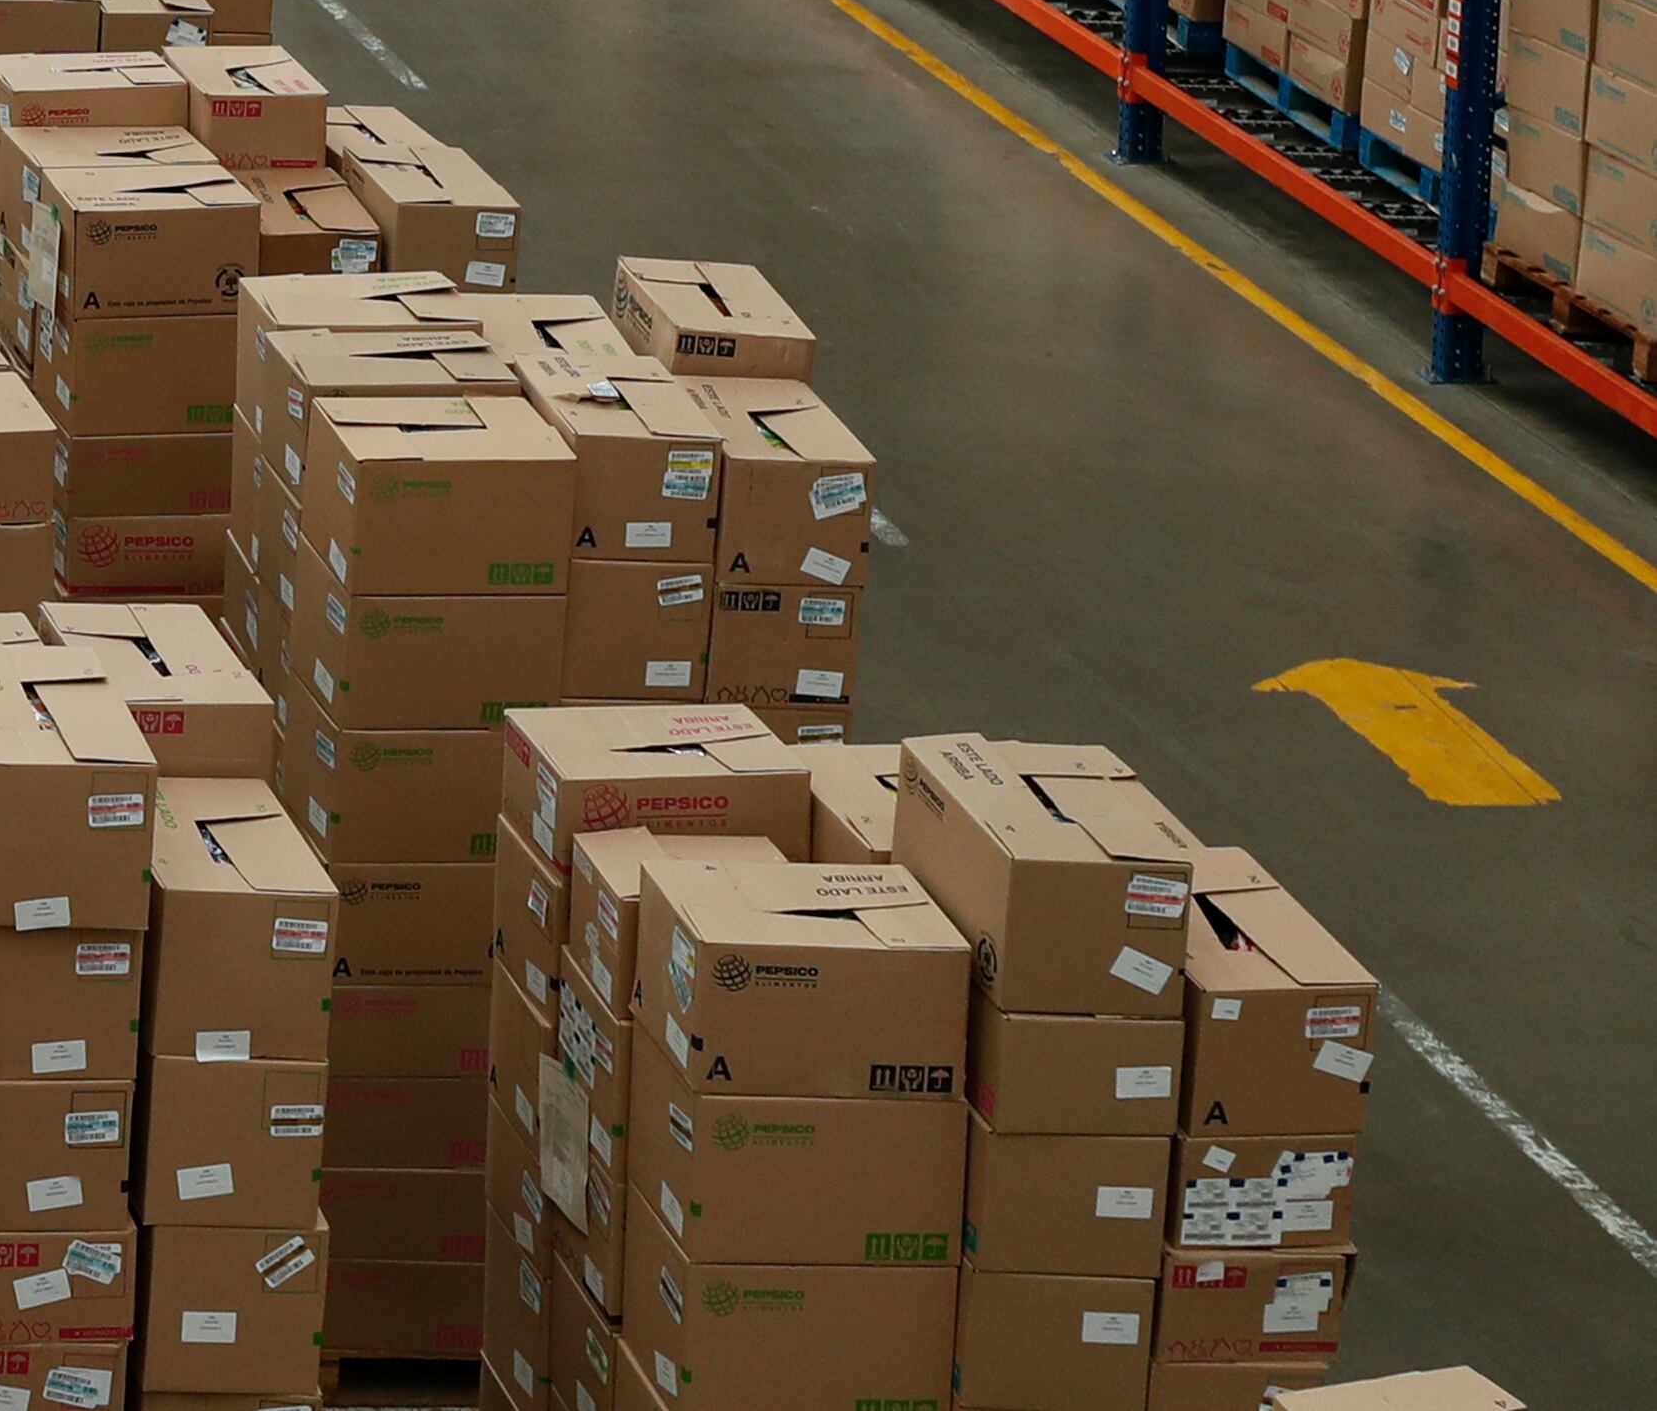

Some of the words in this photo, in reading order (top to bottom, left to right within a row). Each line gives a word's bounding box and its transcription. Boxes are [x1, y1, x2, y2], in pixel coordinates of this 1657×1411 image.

[48, 109, 89, 117] PEPSICO
[114, 224, 157, 232] PEPSICO
[84, 293, 100, 309] A
[577, 527, 596, 547] A
[729, 554, 750, 572] A
[940, 751, 975, 781] ARRIBA
[956, 743, 984, 763] ESTE
[975, 764, 1004, 786] LADO
[637, 796, 729, 810] PEPSICO
[816, 887, 863, 896] LADO
[866, 886, 909, 894] ESTE
[756, 966, 819, 976] PEPSICO
[706, 1055, 732, 1080] A
[1204, 1101, 1228, 1124] A
